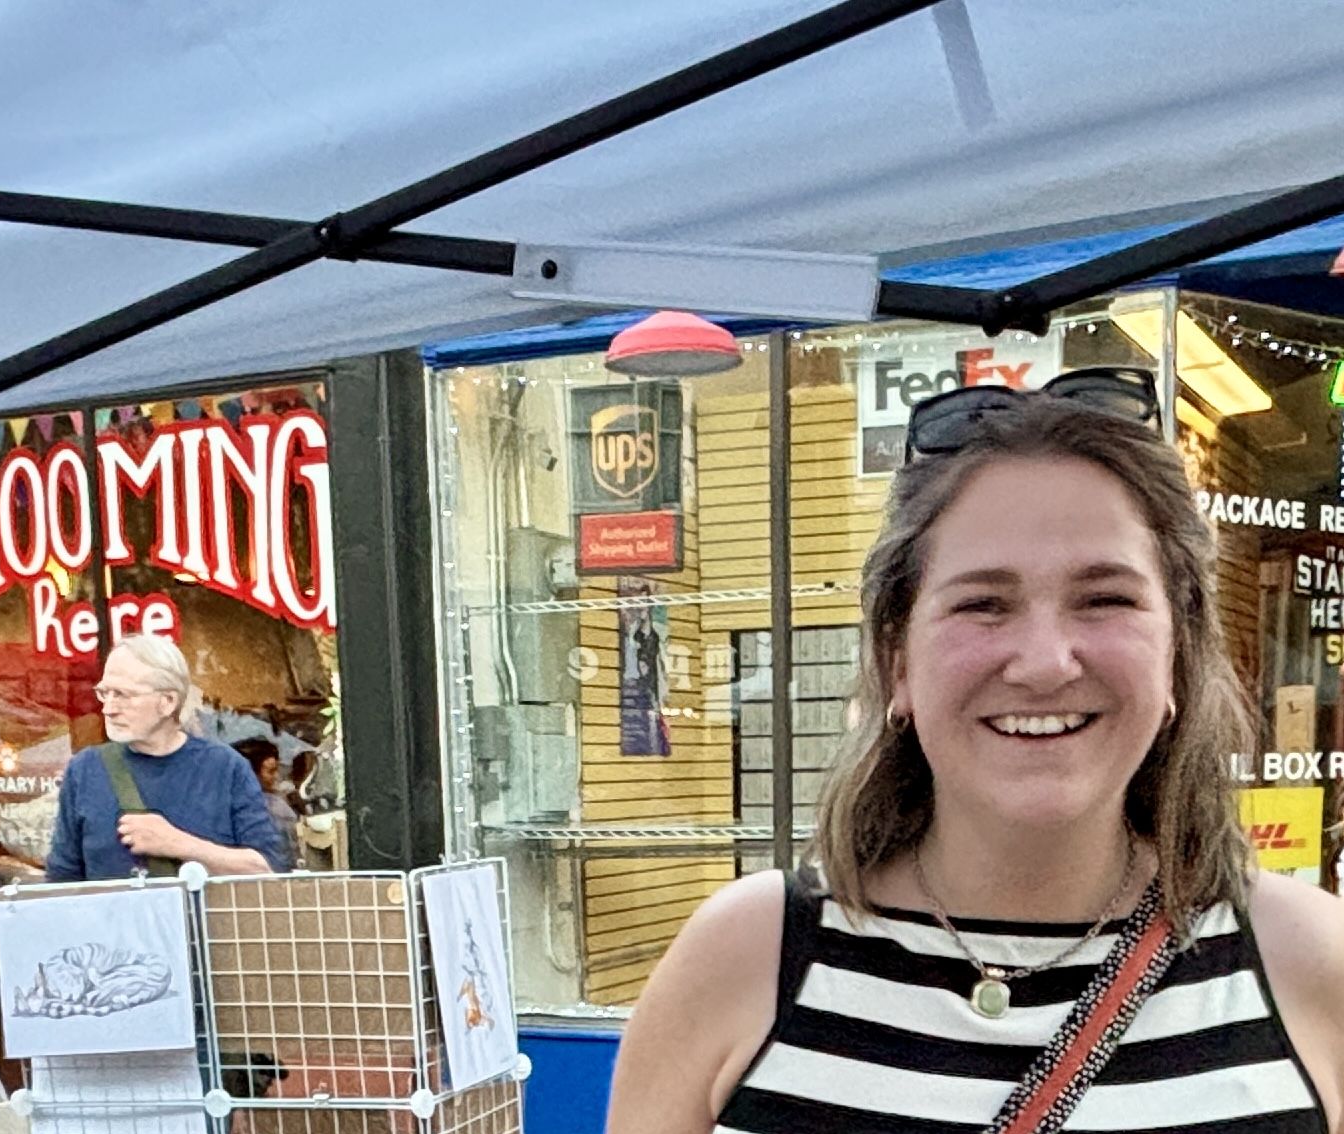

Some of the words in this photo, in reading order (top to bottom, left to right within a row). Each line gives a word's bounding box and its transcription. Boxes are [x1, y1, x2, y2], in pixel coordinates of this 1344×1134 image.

[598, 433, 654, 484] ups
[1196, 491, 1306, 530] PACKAGE
[34, 578, 177, 658] here
[1263, 752, 1324, 781] BOX
